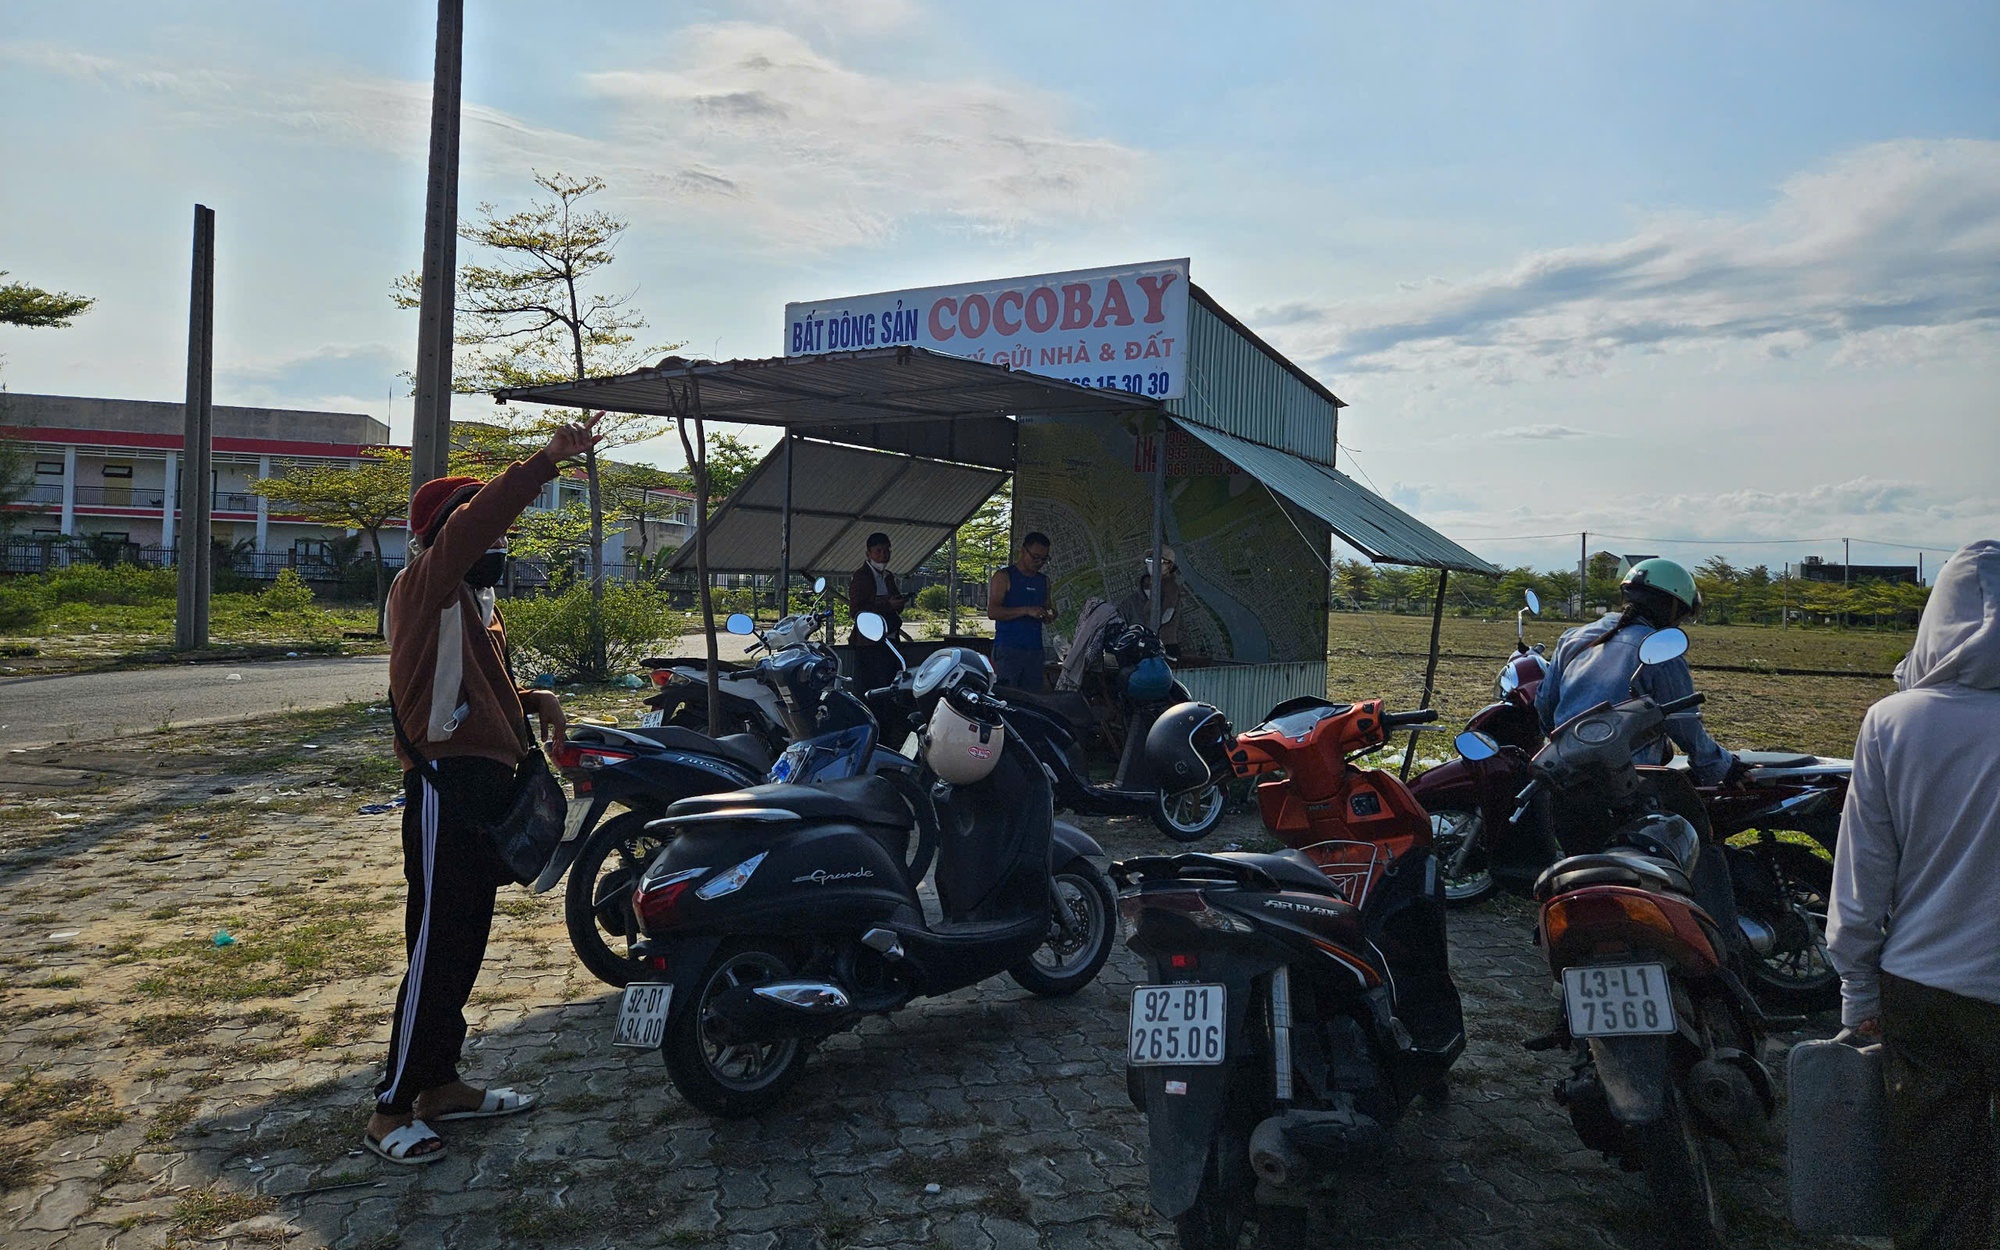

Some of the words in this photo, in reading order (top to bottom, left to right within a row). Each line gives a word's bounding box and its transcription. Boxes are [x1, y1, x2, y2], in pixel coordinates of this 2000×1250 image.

[793, 309, 824, 352] BẤT
[881, 299, 918, 343] SẢN
[928, 273, 1178, 341] COCOBAY
[1040, 339, 1090, 366] NHÀ
[1100, 343, 1115, 361] &
[1125, 330, 1175, 360] ĐẤT
[1122, 374, 1142, 394] 30
[1148, 371, 1169, 395] 30
[1166, 431, 1189, 445] 905
[1166, 447, 1188, 460] 935
[1166, 462, 1188, 475] 966
[810, 866, 874, 885] Grande
[1580, 968, 1649, 998] 43-L1
[1145, 989, 1208, 1022] 92-B1
[1582, 1000, 1658, 1031] 7568
[1134, 1026, 1218, 1060] 265.06
